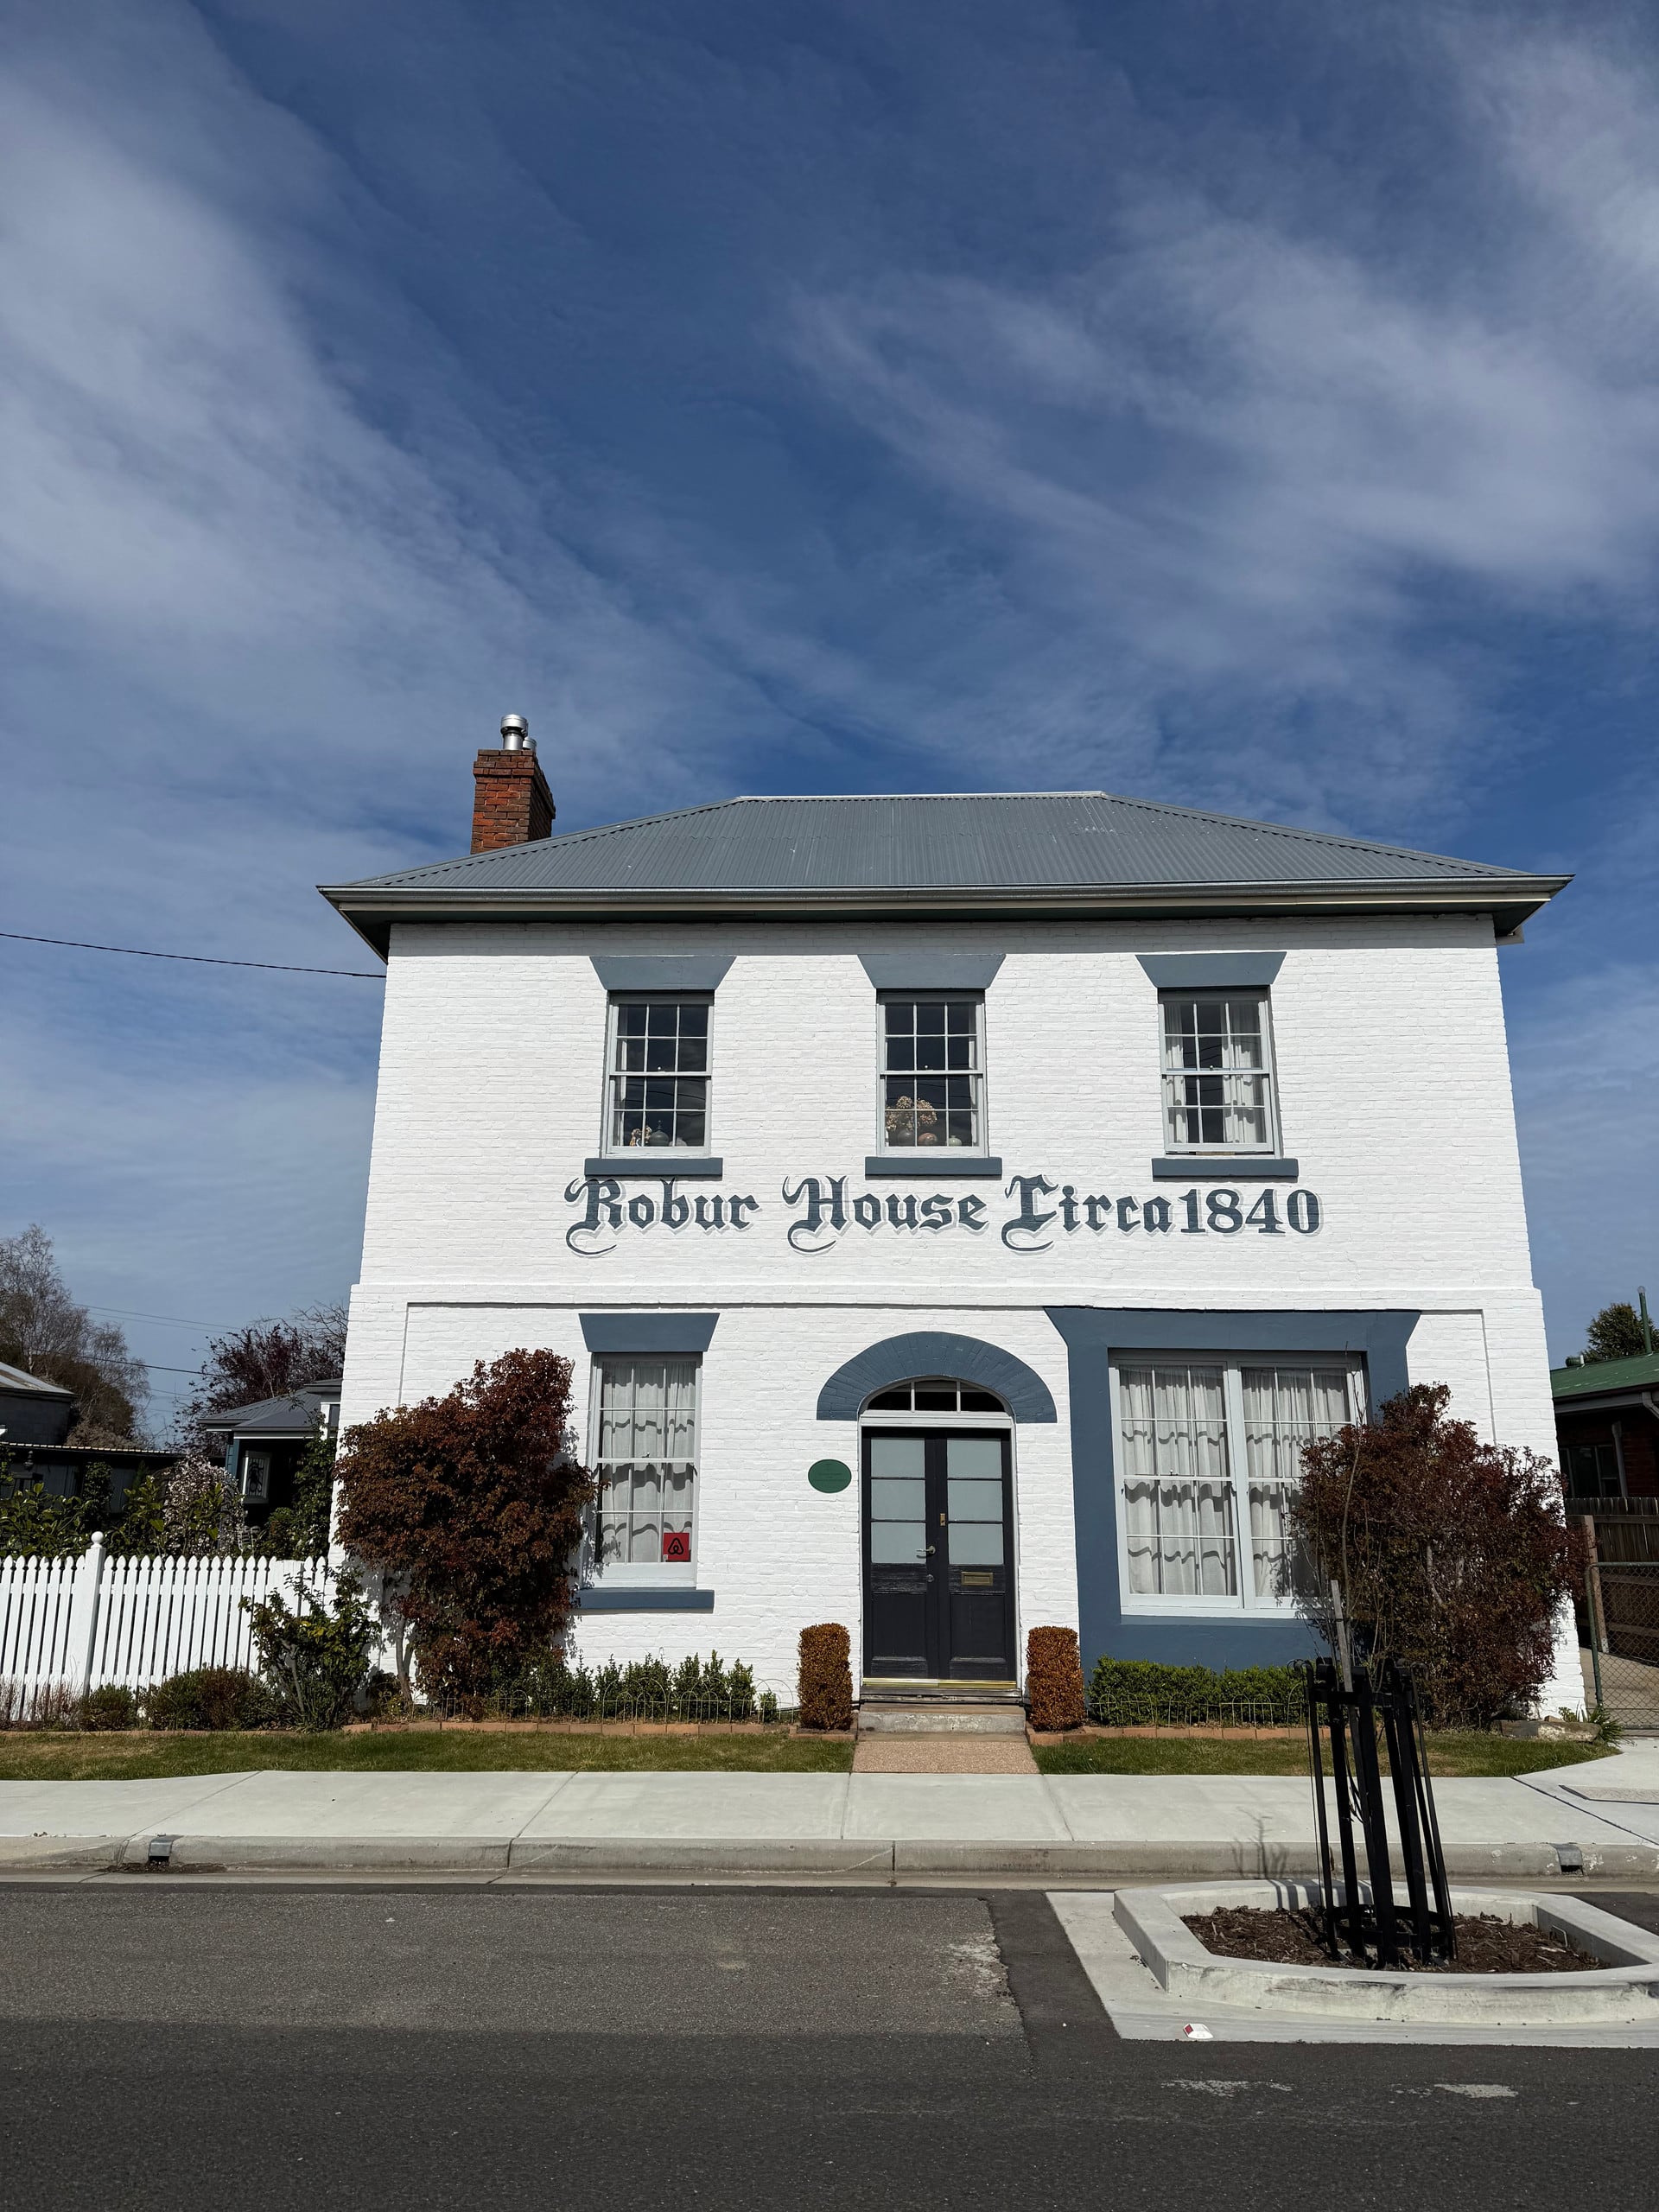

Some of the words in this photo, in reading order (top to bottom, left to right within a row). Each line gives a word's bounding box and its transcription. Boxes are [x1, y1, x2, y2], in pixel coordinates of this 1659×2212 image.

[563, 1176, 760, 1255] Robur
[781, 1175, 990, 1253] House
[1178, 1188, 1321, 1234] 1840
